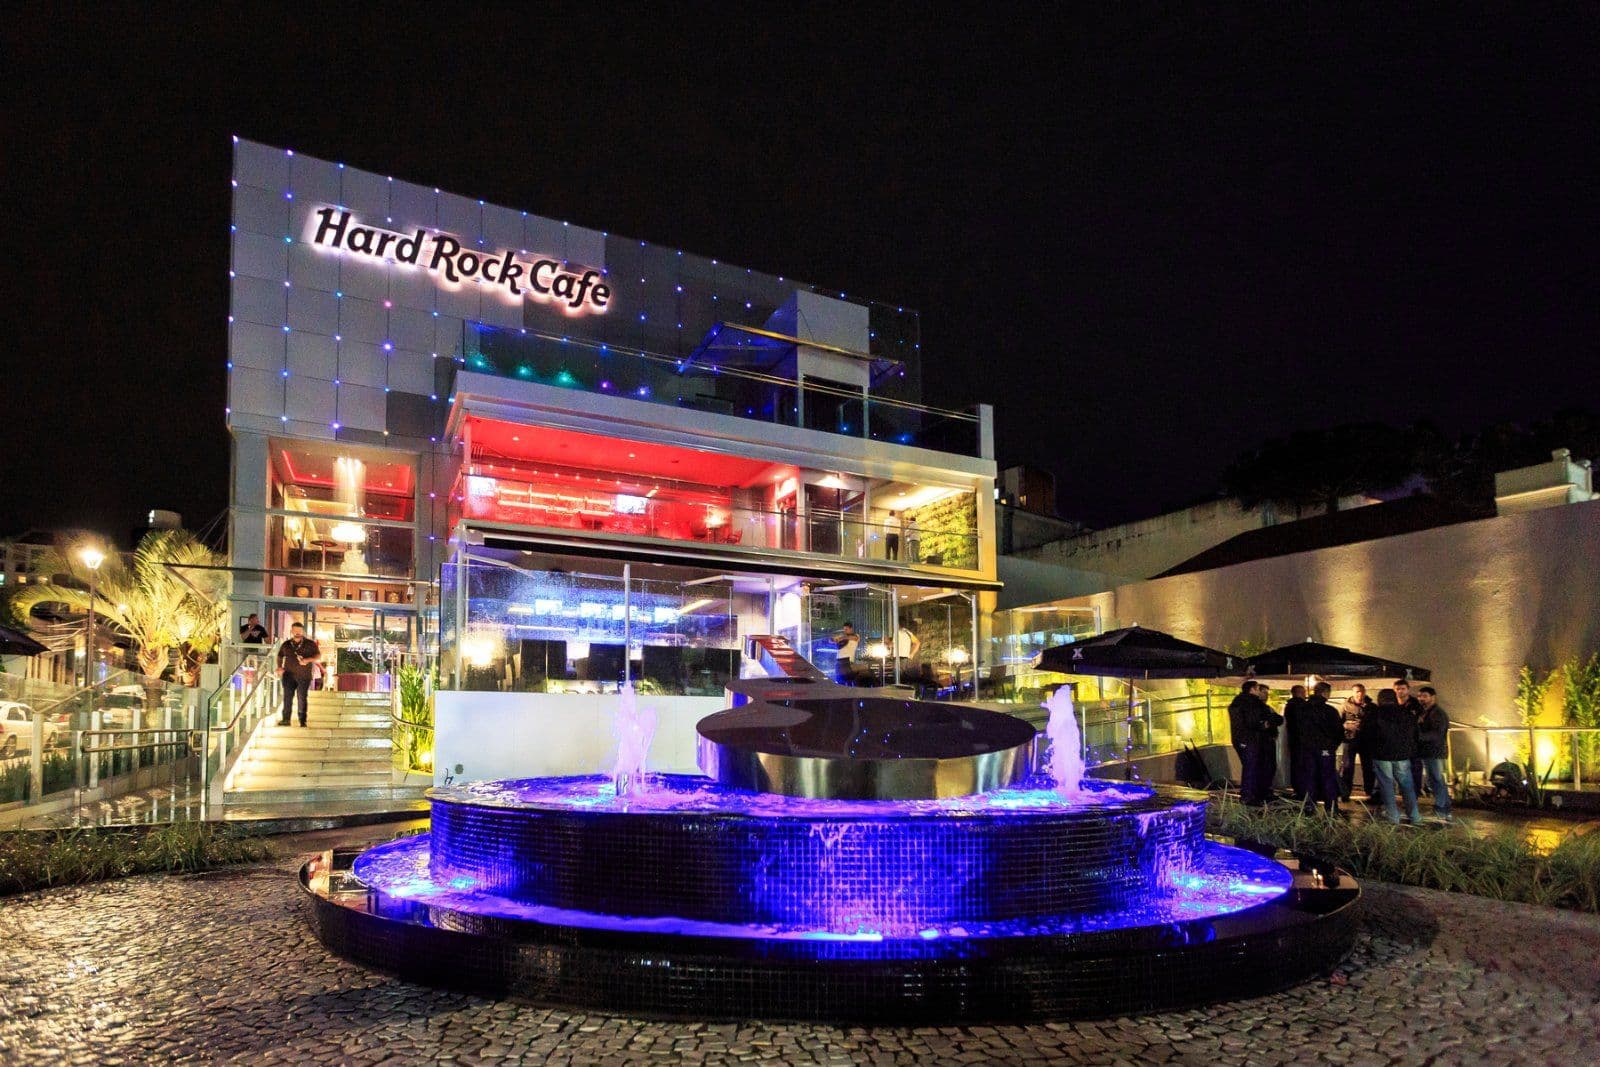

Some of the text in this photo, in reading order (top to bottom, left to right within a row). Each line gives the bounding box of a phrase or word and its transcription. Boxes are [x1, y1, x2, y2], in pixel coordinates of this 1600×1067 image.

[313, 207, 611, 308] Hard Rock Cafe
